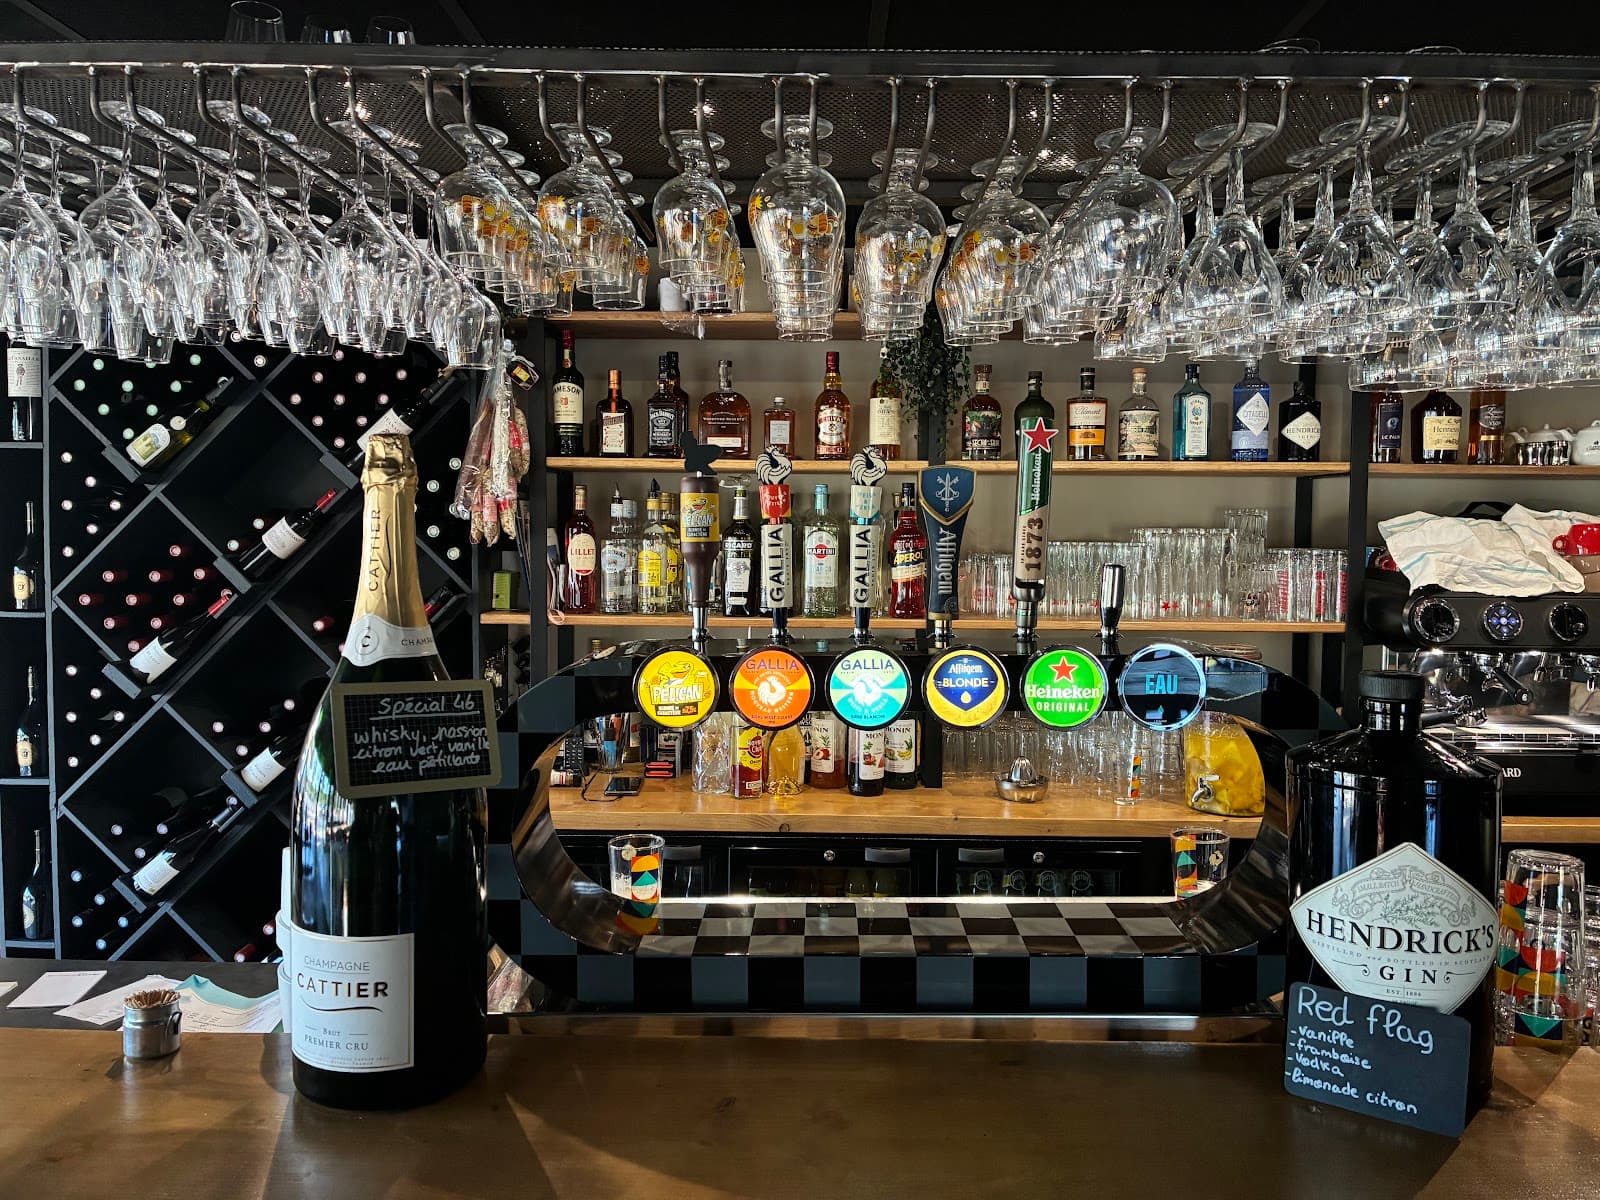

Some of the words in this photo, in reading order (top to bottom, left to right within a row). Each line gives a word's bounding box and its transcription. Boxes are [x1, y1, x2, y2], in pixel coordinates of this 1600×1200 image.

[1030, 453, 1042, 501] Heineken
[369, 509, 380, 592] CATTIER
[1025, 517, 1043, 572] 1873
[768, 527, 785, 602] GALLIA
[854, 528, 871, 603] GALLIA
[894, 551, 923, 565] APEROL
[935, 527, 957, 595] Affligem
[745, 658, 800, 671] GALLIA
[841, 658, 894, 671] GALLIA
[948, 663, 983, 675] Affligem
[942, 677, 989, 688] BLONDE
[1145, 674, 1178, 695] EAU
[653, 684, 702, 702] PELICAN
[1026, 684, 1100, 699] Heineken
[453, 694, 475, 711] 46
[1036, 702, 1090, 712] ORIGINAL
[352, 746, 402, 760] citron
[372, 760, 413, 773] eau
[1306, 908, 1494, 954] HENDRICK'S
[304, 955, 370, 971] CHAMPAGNE
[1387, 957, 1434, 966] BOTTLED
[1454, 955, 1490, 966] SCOTLAND
[1379, 965, 1438, 984] GIN
[297, 972, 389, 998] CATTIER
[1297, 986, 1354, 1026] Red
[1366, 1003, 1434, 1055] flag
[304, 1034, 341, 1050] PREMIER
[345, 1042, 369, 1051] CRU
[1366, 1092, 1418, 1114] citron
